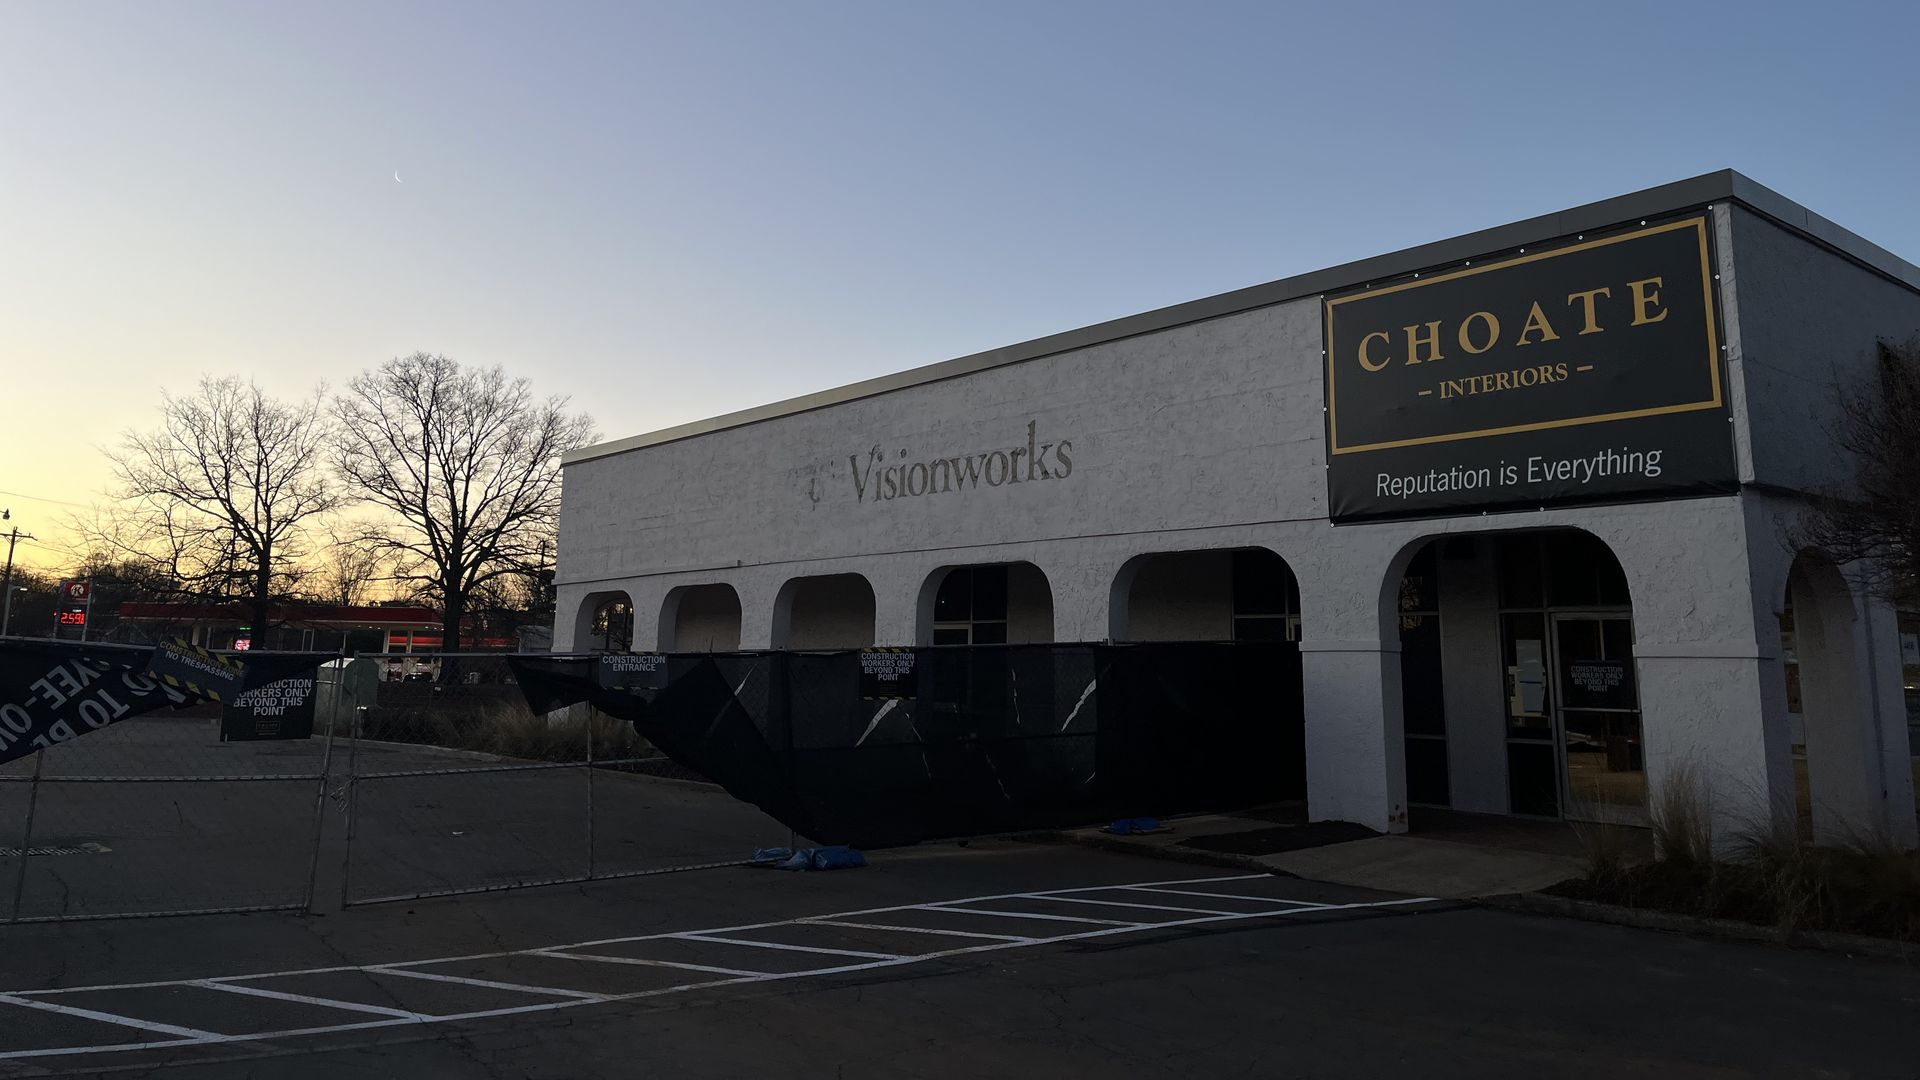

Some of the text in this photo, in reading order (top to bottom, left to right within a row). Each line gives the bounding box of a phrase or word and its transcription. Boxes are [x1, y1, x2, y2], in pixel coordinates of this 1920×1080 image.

[1358, 276, 1668, 372] CHOATE
[1439, 362, 1568, 399] INTERIORS
[850, 419, 1073, 503] Visionworks
[1376, 446, 1662, 498] Reputation is Everything
[165, 651, 235, 681] NO TRESPASSING
[602, 656, 666, 664] CONSTRUCTION
[239, 688, 312, 698] ORKERS ONLY
[262, 679, 312, 688] RUCTION
[233, 697, 304, 707] BEYOND THIS
[253, 706, 286, 716] POINT
